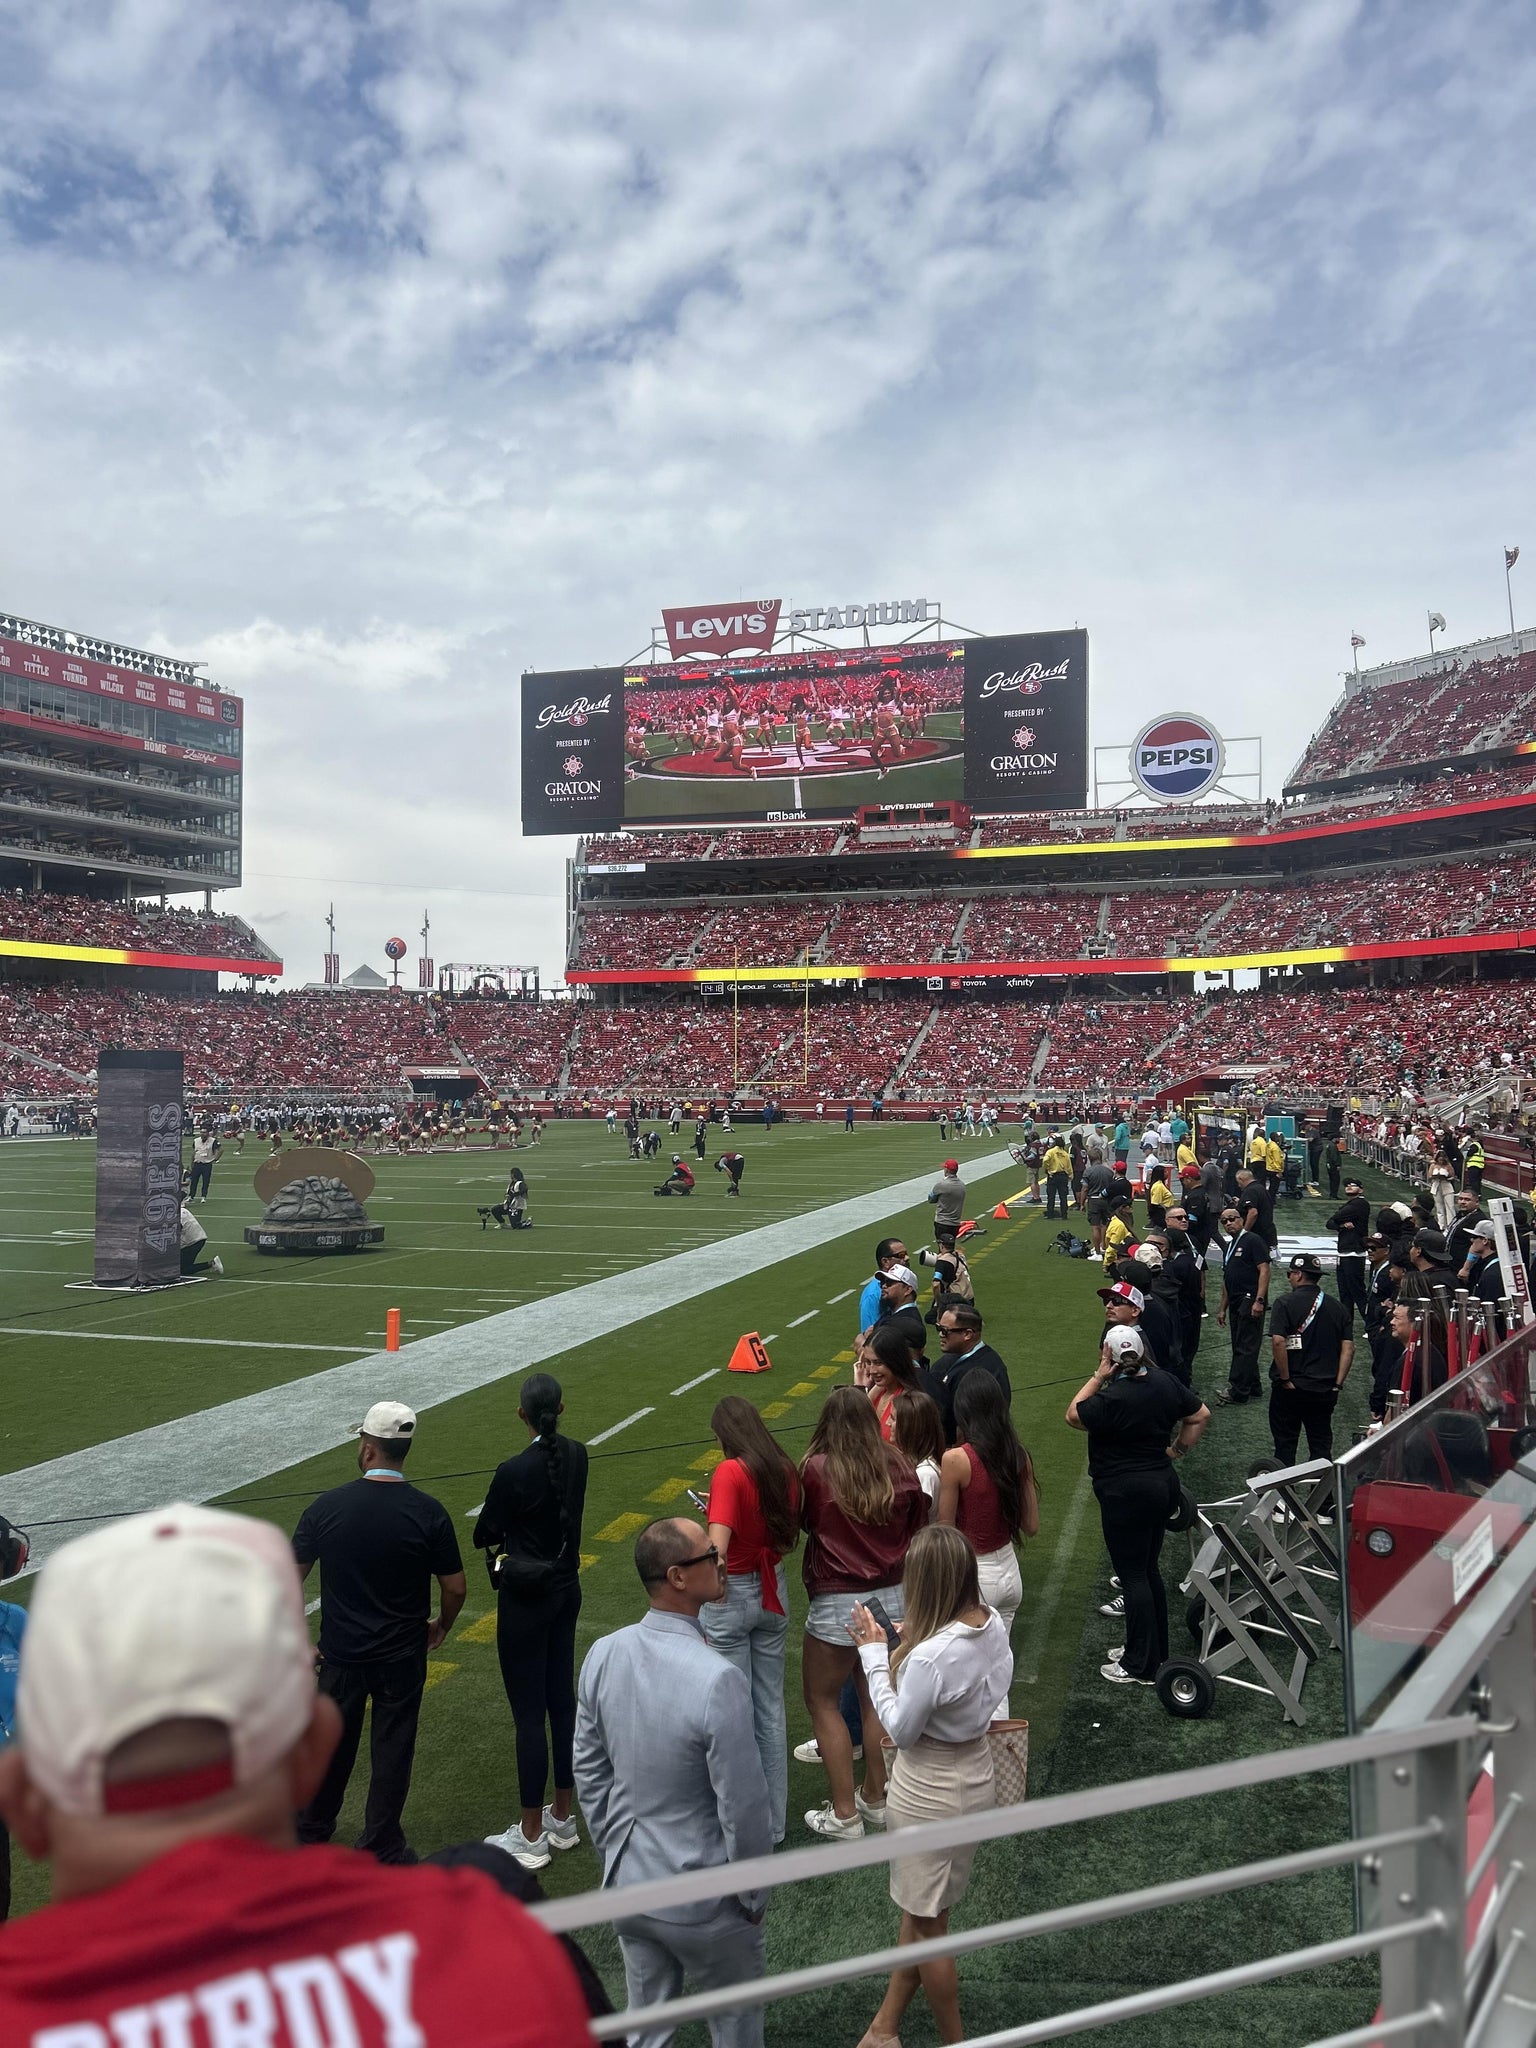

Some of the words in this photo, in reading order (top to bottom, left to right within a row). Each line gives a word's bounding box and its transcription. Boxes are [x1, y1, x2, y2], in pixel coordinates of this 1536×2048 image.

[788, 599, 928, 632] STADIUM
[23, 661, 50, 677] TITTLE
[62, 670, 88, 686] TURNER
[100, 679, 125, 695] WILCOX
[135, 688, 156, 702] WILLIS
[167, 696, 186, 709] YOUNG
[196, 703, 215, 716] YOUNG
[1003, 708, 1035, 718] PRESENTED
[1036, 707, 1045, 716] BY
[144, 740, 167, 754] HOME
[556, 739, 583, 748] PRESENTED
[583, 738, 591, 746] BY
[990, 752, 1058, 771] GRATON
[1141, 747, 1213, 767] PEPSI
[544, 780, 601, 796] GRATON
[905, 802, 934, 810] STADIUM
[767, 812, 781, 821] us
[782, 810, 807, 820] bank
[1006, 978, 1034, 988] xfinity
[143, 1102, 182, 1253] 49ERS
[749, 1337, 768, 1367] G
